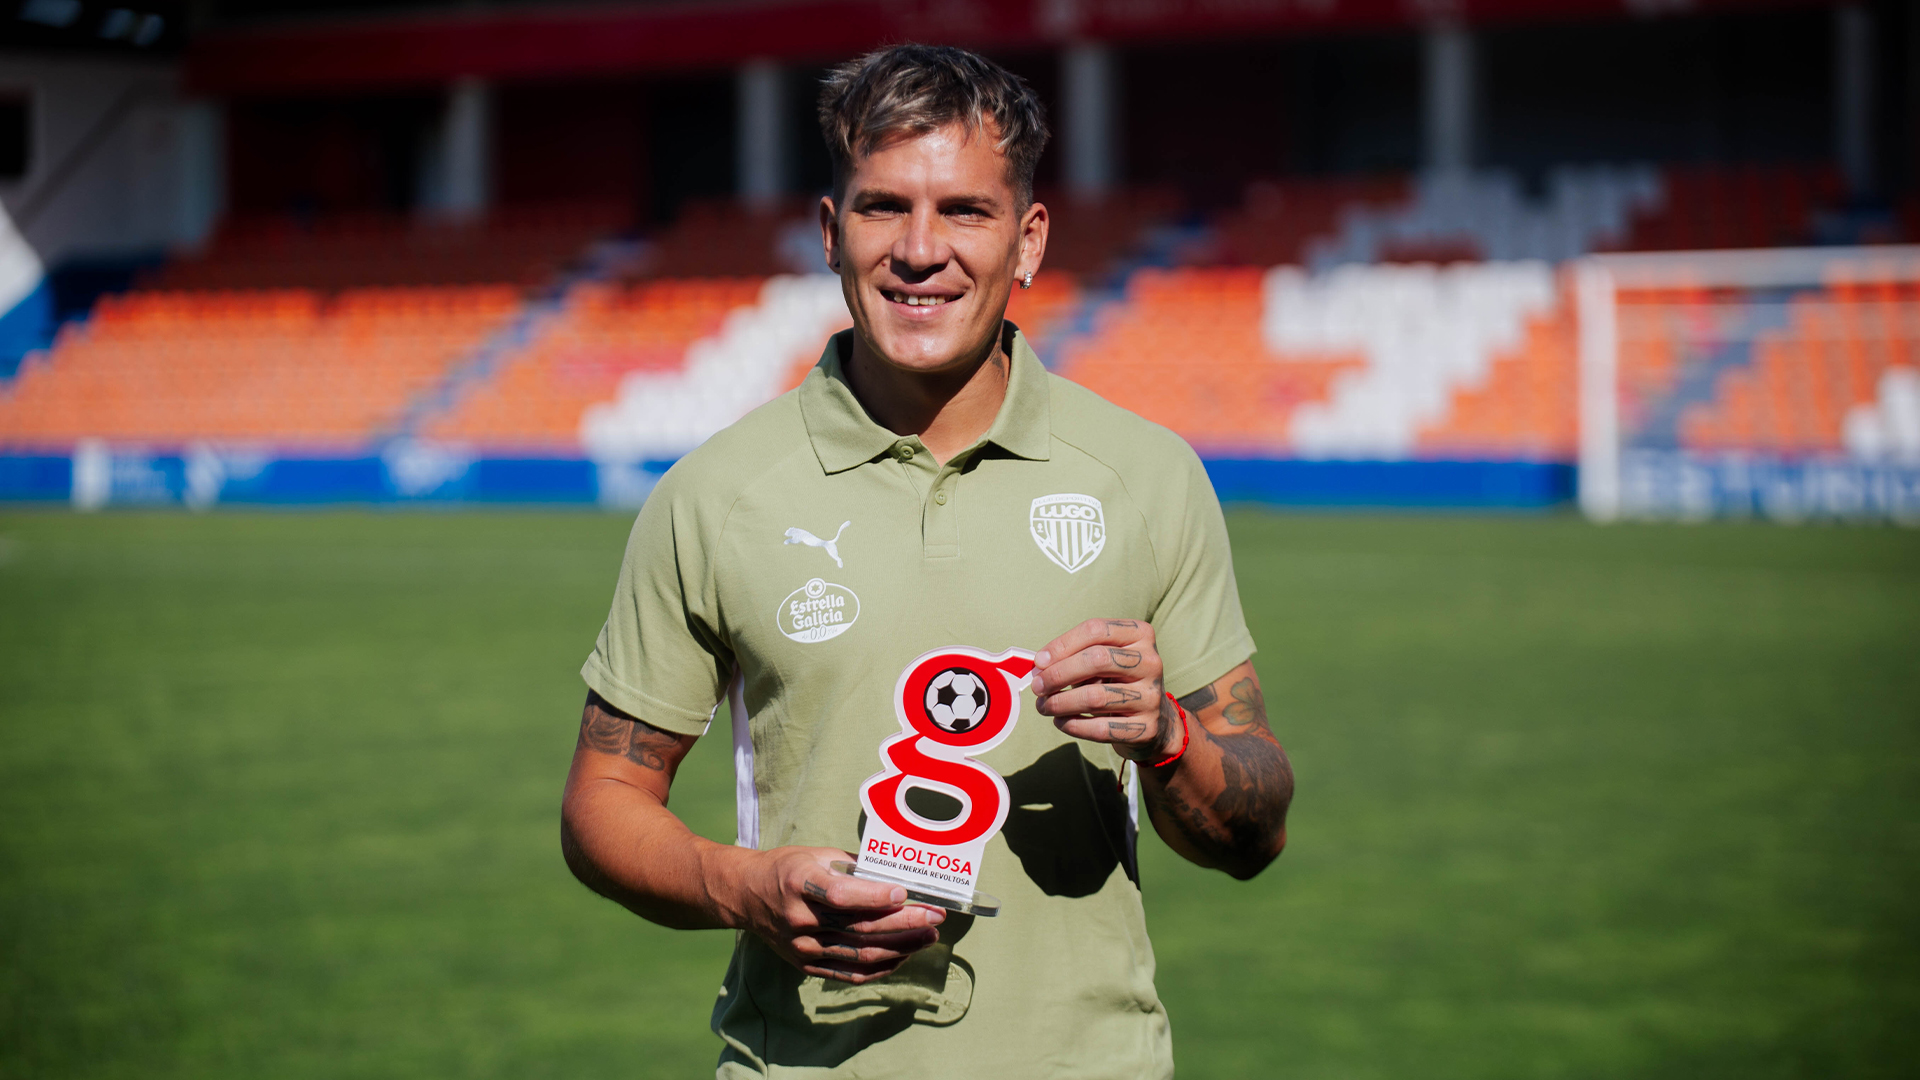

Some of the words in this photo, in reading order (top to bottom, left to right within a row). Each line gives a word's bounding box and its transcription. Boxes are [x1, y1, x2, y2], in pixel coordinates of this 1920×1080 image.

[1039, 504, 1097, 520] LUGO
[789, 593, 845, 616] Estrella
[792, 608, 844, 630] Galicia
[867, 838, 972, 876] REVOLTOSA
[864, 855, 897, 869] XOGADOR
[899, 863, 928, 877] ENERXÍA
[929, 871, 970, 886] REVOLTOSA
